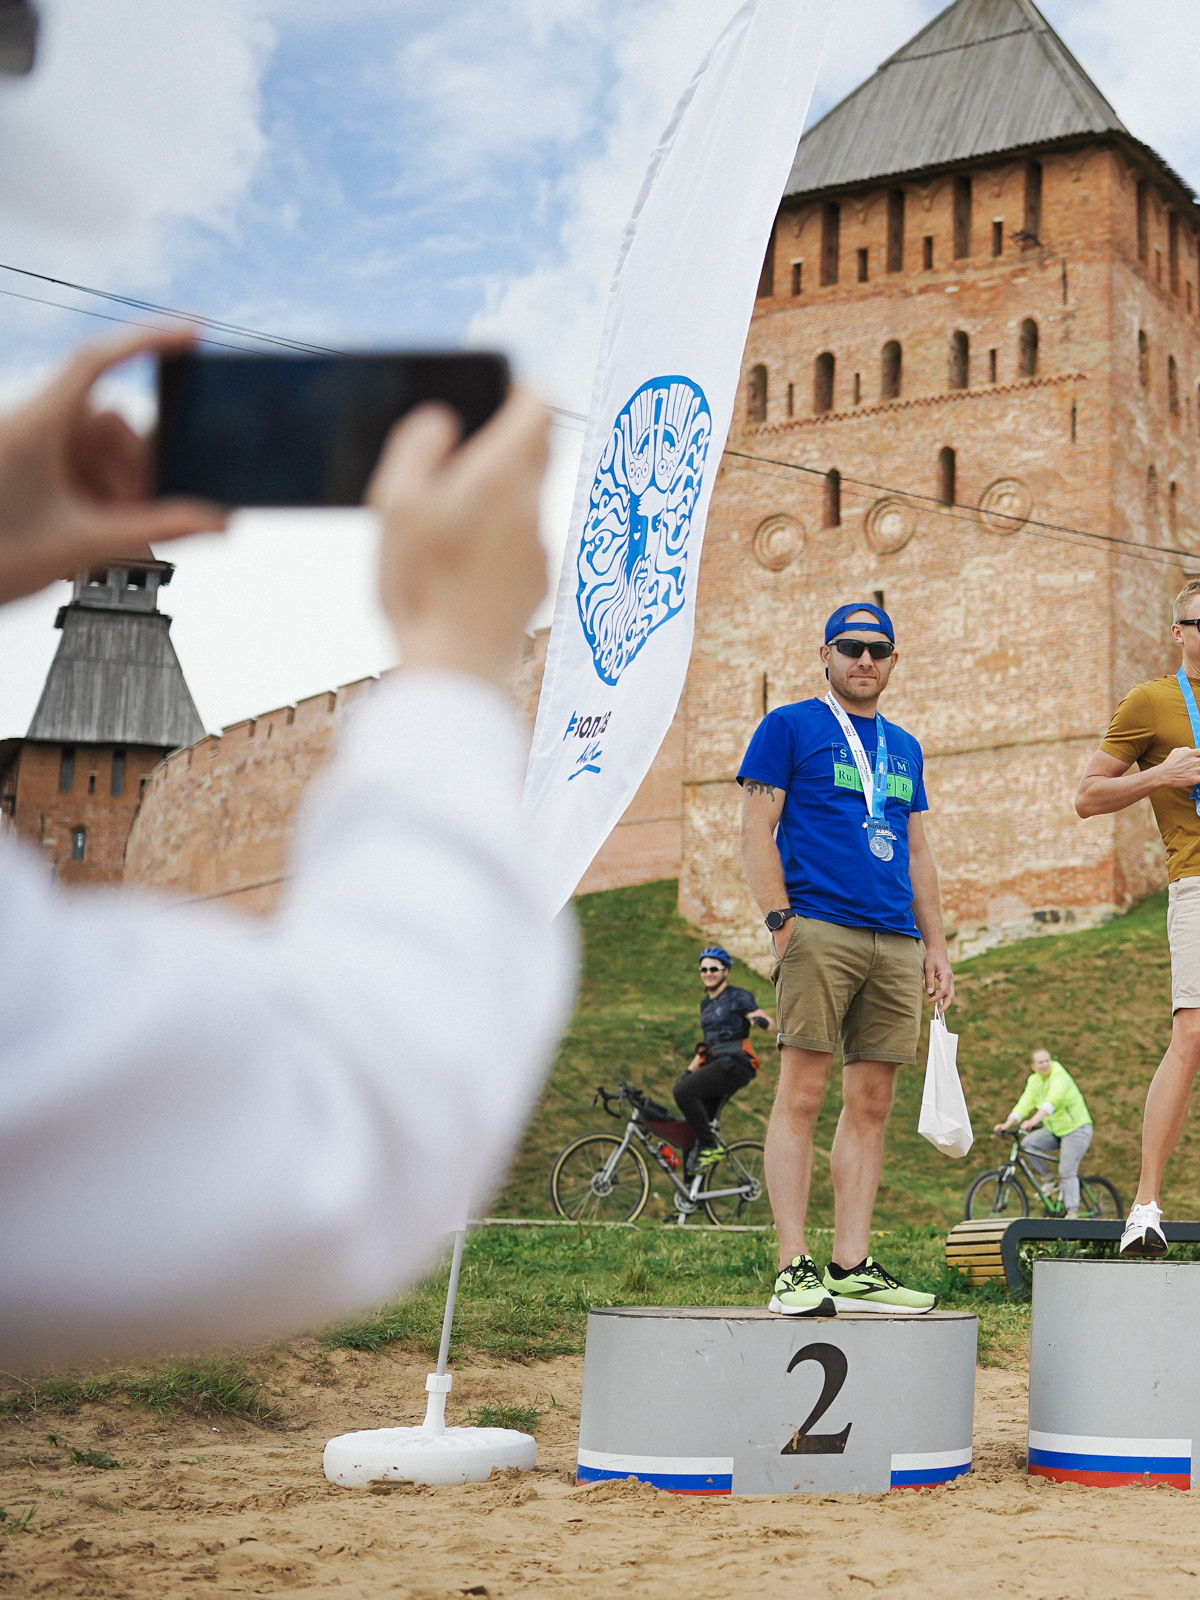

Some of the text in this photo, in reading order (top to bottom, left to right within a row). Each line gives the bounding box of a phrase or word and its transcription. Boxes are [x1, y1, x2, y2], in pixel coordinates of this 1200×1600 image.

[840, 749, 907, 771] S M
[838, 770, 852, 781] Ru
[902, 783, 908, 792] R
[780, 1343, 852, 1455] 2
